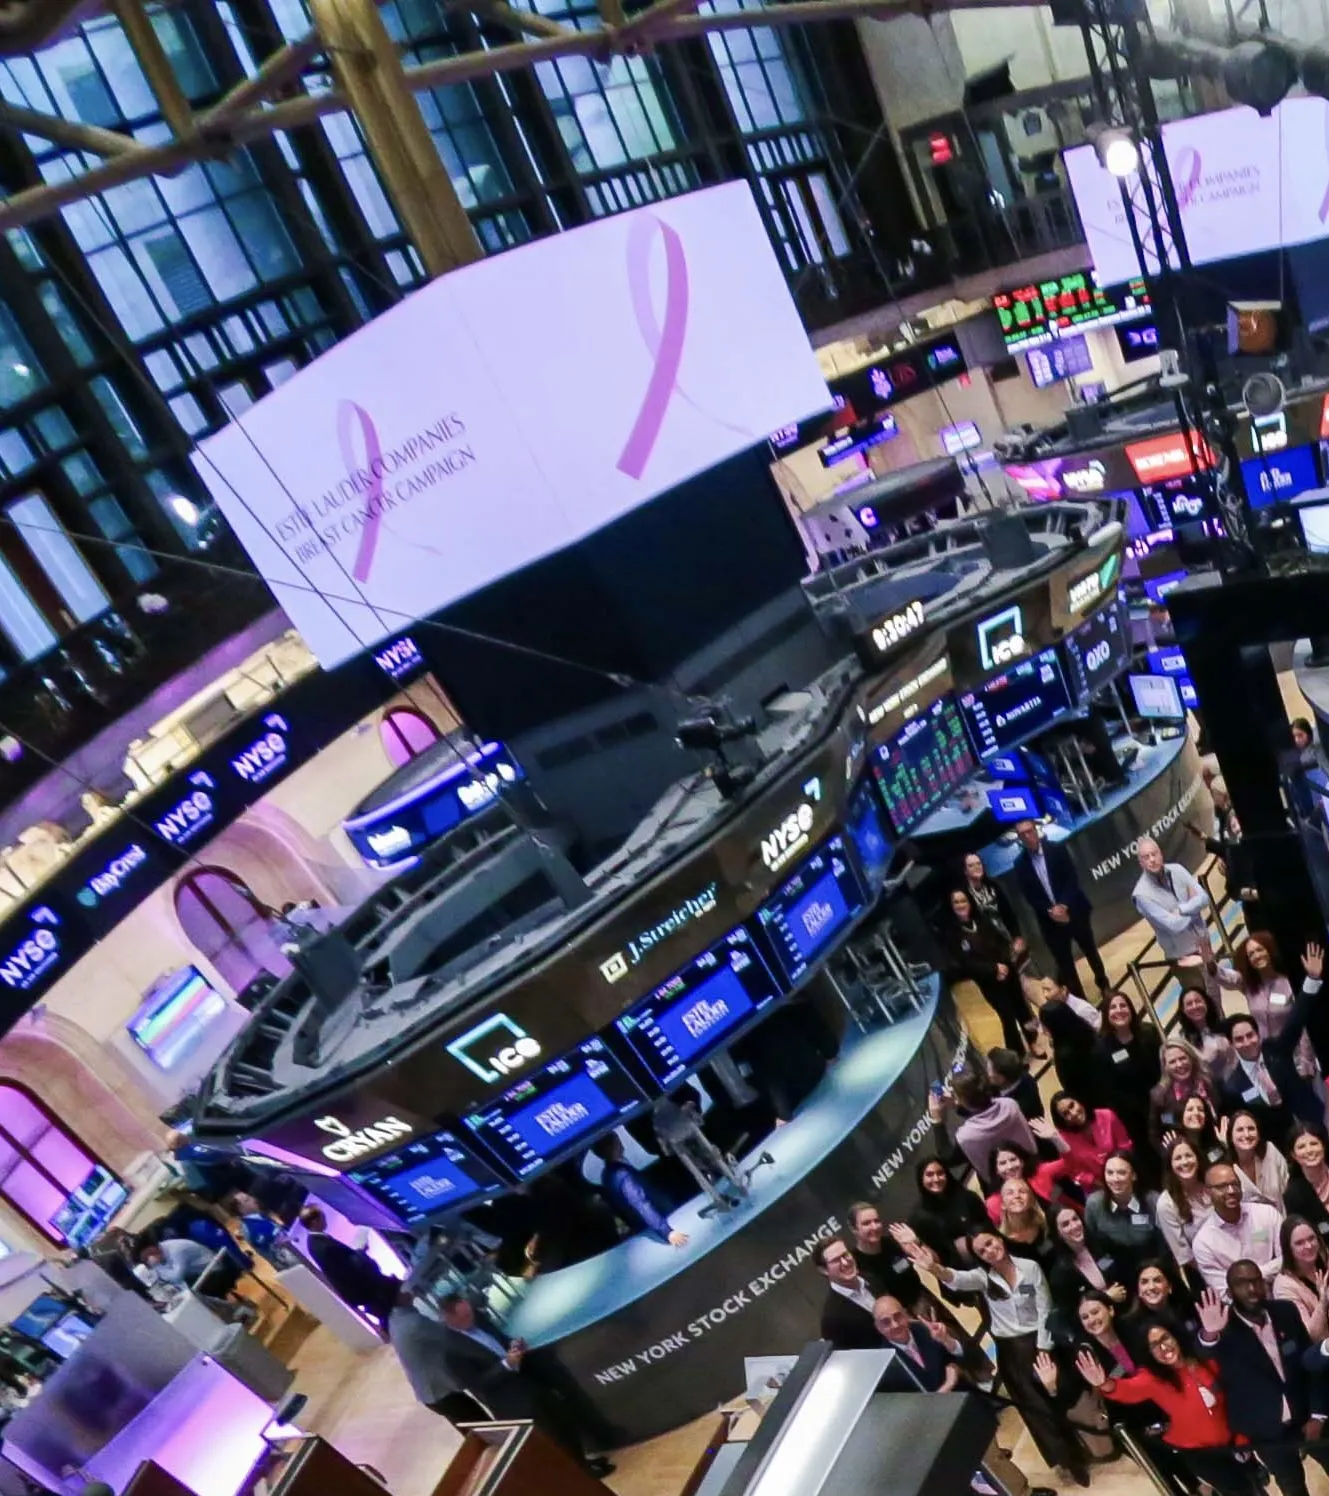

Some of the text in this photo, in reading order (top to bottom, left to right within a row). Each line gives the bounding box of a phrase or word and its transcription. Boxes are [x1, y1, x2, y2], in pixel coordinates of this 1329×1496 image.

[370, 411, 466, 480] COMPANIES
[394, 444, 478, 505] CAMPAIGN
[1090, 852, 1122, 881] NEW
[871, 1110, 937, 1190] NEW YORK
[593, 1215, 843, 1386] NEW YORK STOCK EXCHANGE
